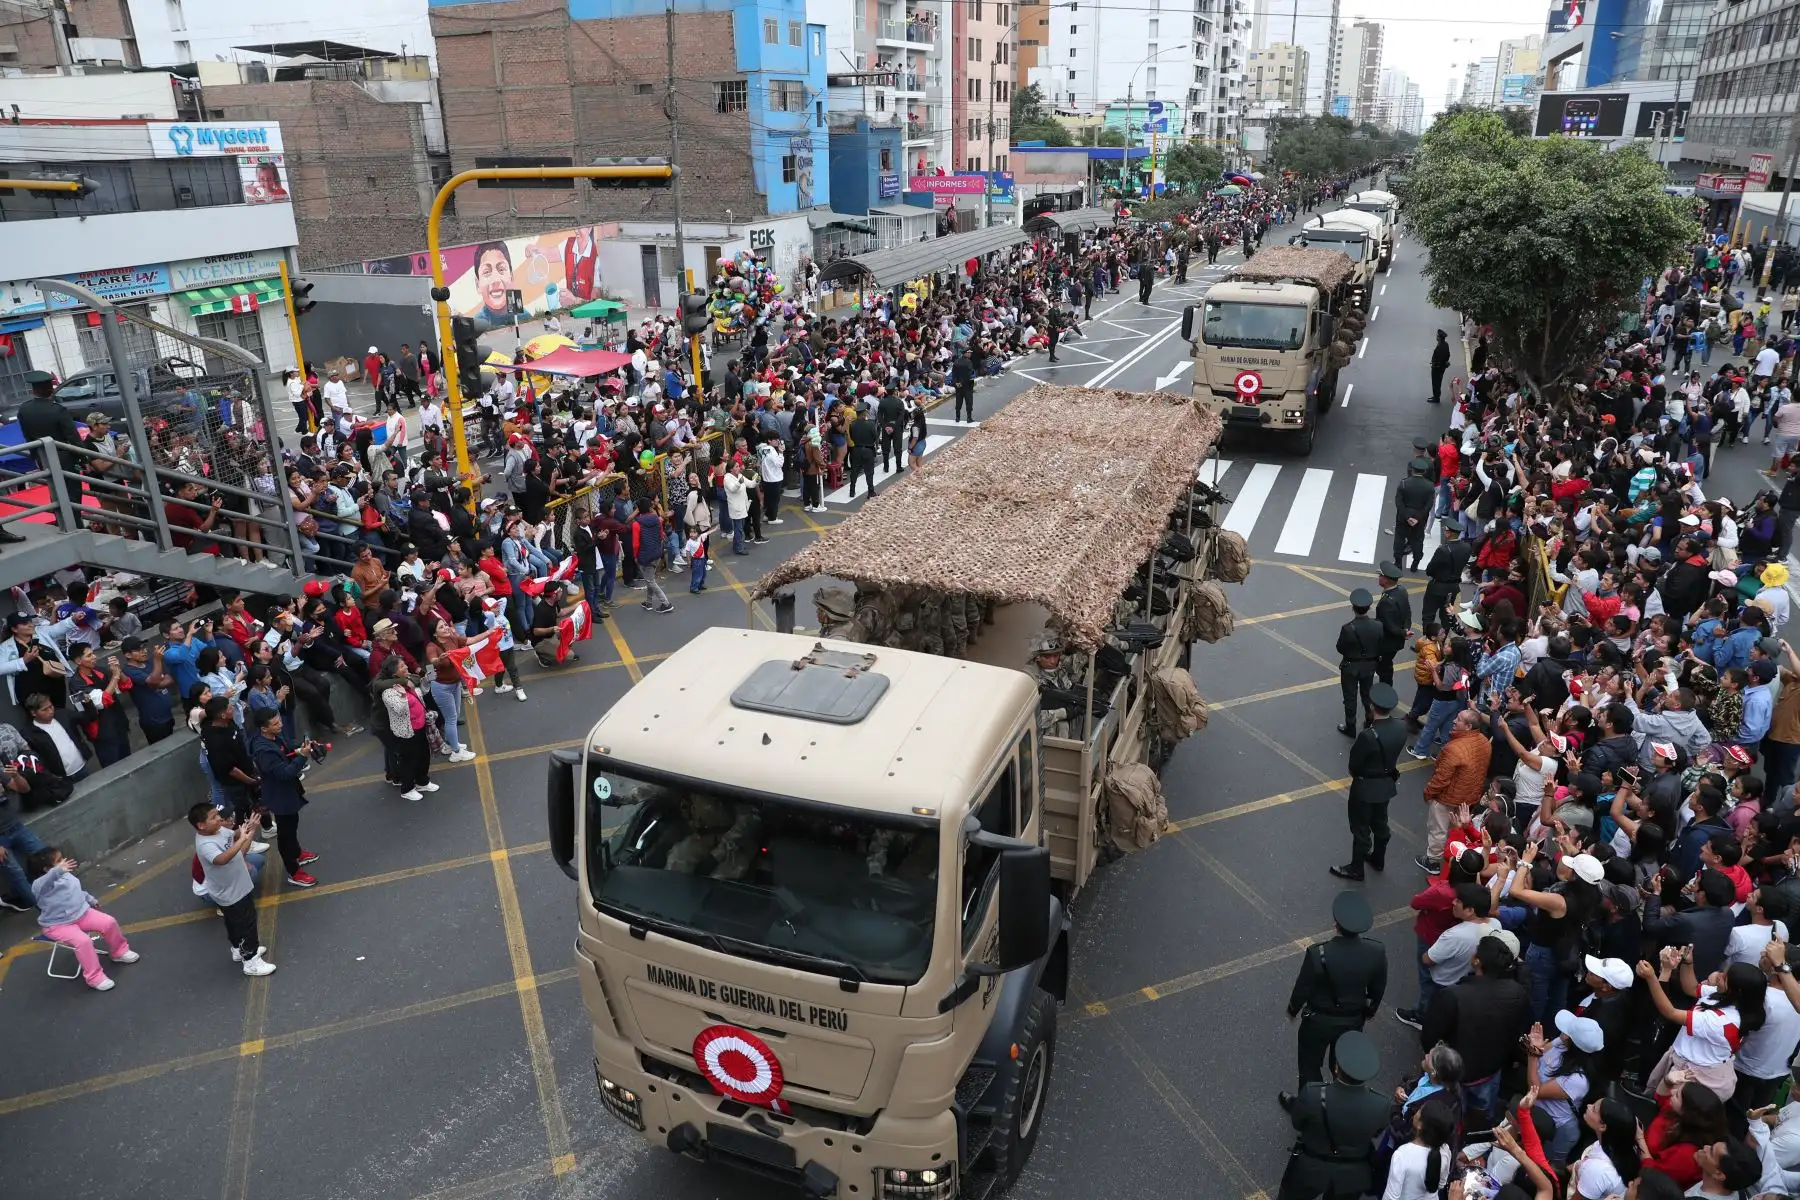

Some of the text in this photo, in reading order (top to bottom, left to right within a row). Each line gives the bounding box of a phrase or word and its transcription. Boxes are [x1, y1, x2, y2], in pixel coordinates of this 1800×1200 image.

[196, 127, 268, 151] Mydent
[926, 180, 967, 188] INFORMES
[204, 252, 254, 264] ORTOPEDIA
[178, 260, 257, 283] VICENTE
[101, 292, 128, 301] RASIL
[597, 783, 609, 793] 14
[646, 963, 849, 1032] MARINA DE GUERRA DEL PERÚ
